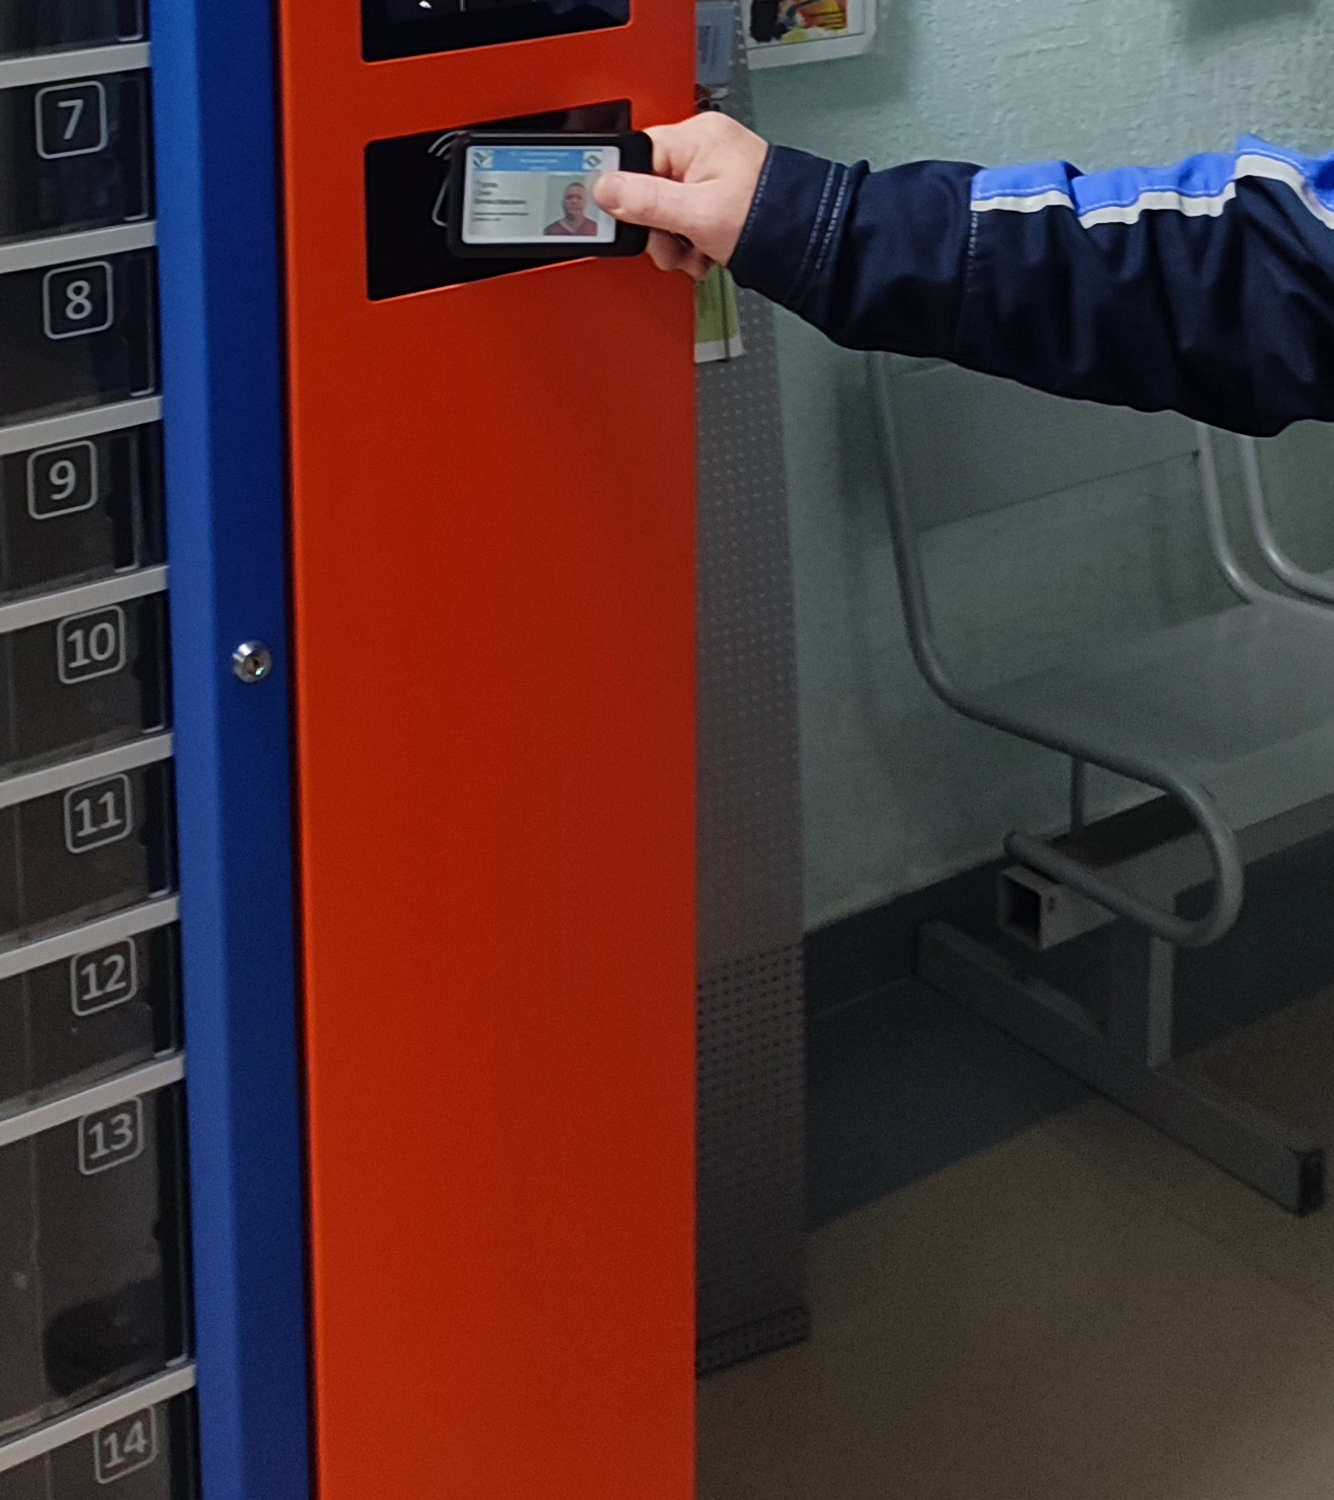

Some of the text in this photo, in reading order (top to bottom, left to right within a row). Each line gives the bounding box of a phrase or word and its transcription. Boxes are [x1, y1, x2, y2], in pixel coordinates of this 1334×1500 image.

[57, 99, 84, 140] 7
[65, 280, 92, 320] 8
[49, 460, 76, 500] 9
[67, 622, 116, 668] 10
[74, 791, 121, 837] 11
[80, 954, 127, 1000] 12
[87, 1112, 134, 1159] 13
[103, 1420, 147, 1469] 14
